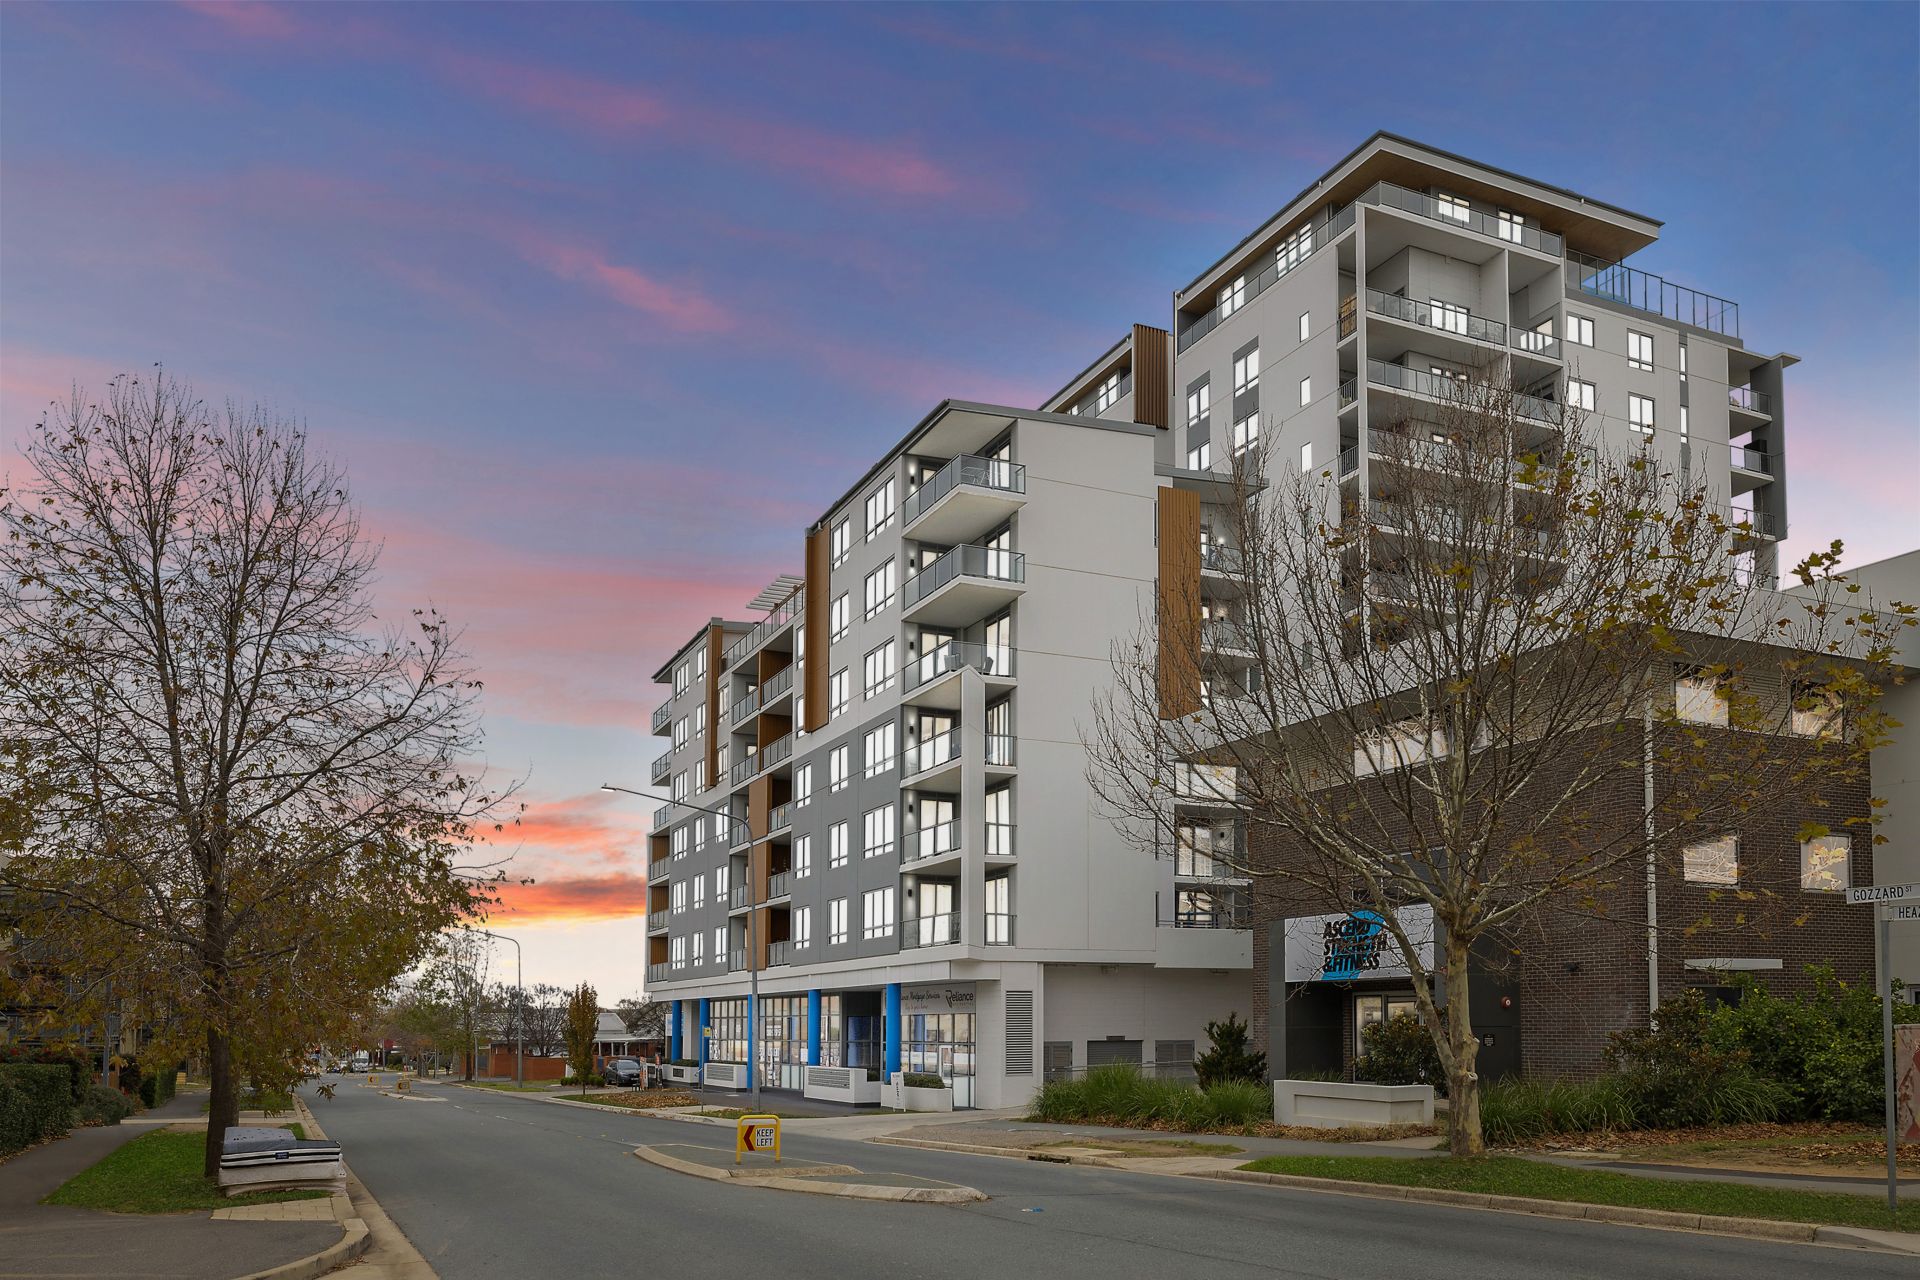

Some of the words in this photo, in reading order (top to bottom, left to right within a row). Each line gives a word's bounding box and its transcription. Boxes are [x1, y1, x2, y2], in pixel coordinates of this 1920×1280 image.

[1853, 886, 1904, 901] GOZZARD
[1323, 919, 1371, 939] ASCEND
[1323, 934, 1388, 955] STRENGTH
[945, 989, 974, 1008] Reliance
[756, 1128, 774, 1137] KEEP
[756, 1138, 773, 1147] LEFT
